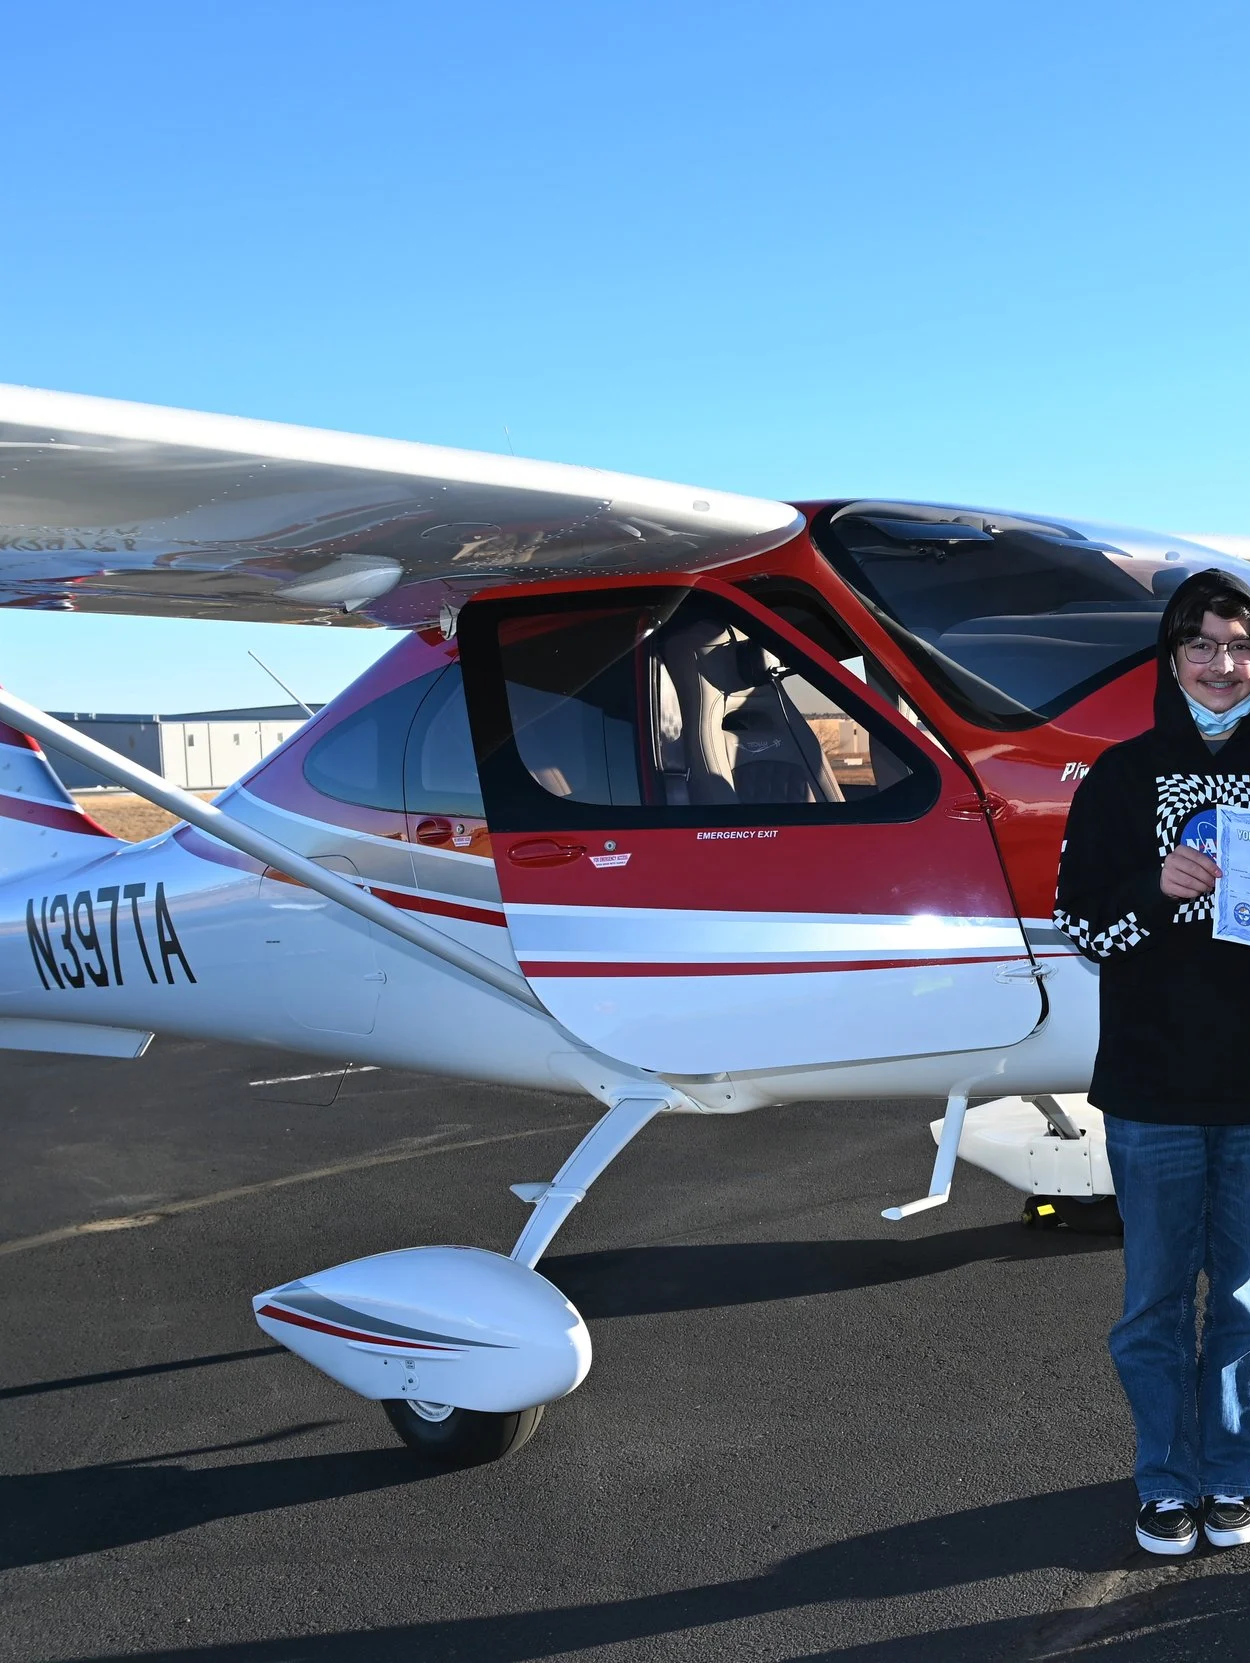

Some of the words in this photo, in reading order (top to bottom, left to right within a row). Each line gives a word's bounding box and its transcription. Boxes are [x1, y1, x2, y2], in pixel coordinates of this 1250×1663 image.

[696, 830, 756, 840] EMERGENCY
[757, 830, 778, 838] EXIT
[26, 881, 198, 991] N397TA
